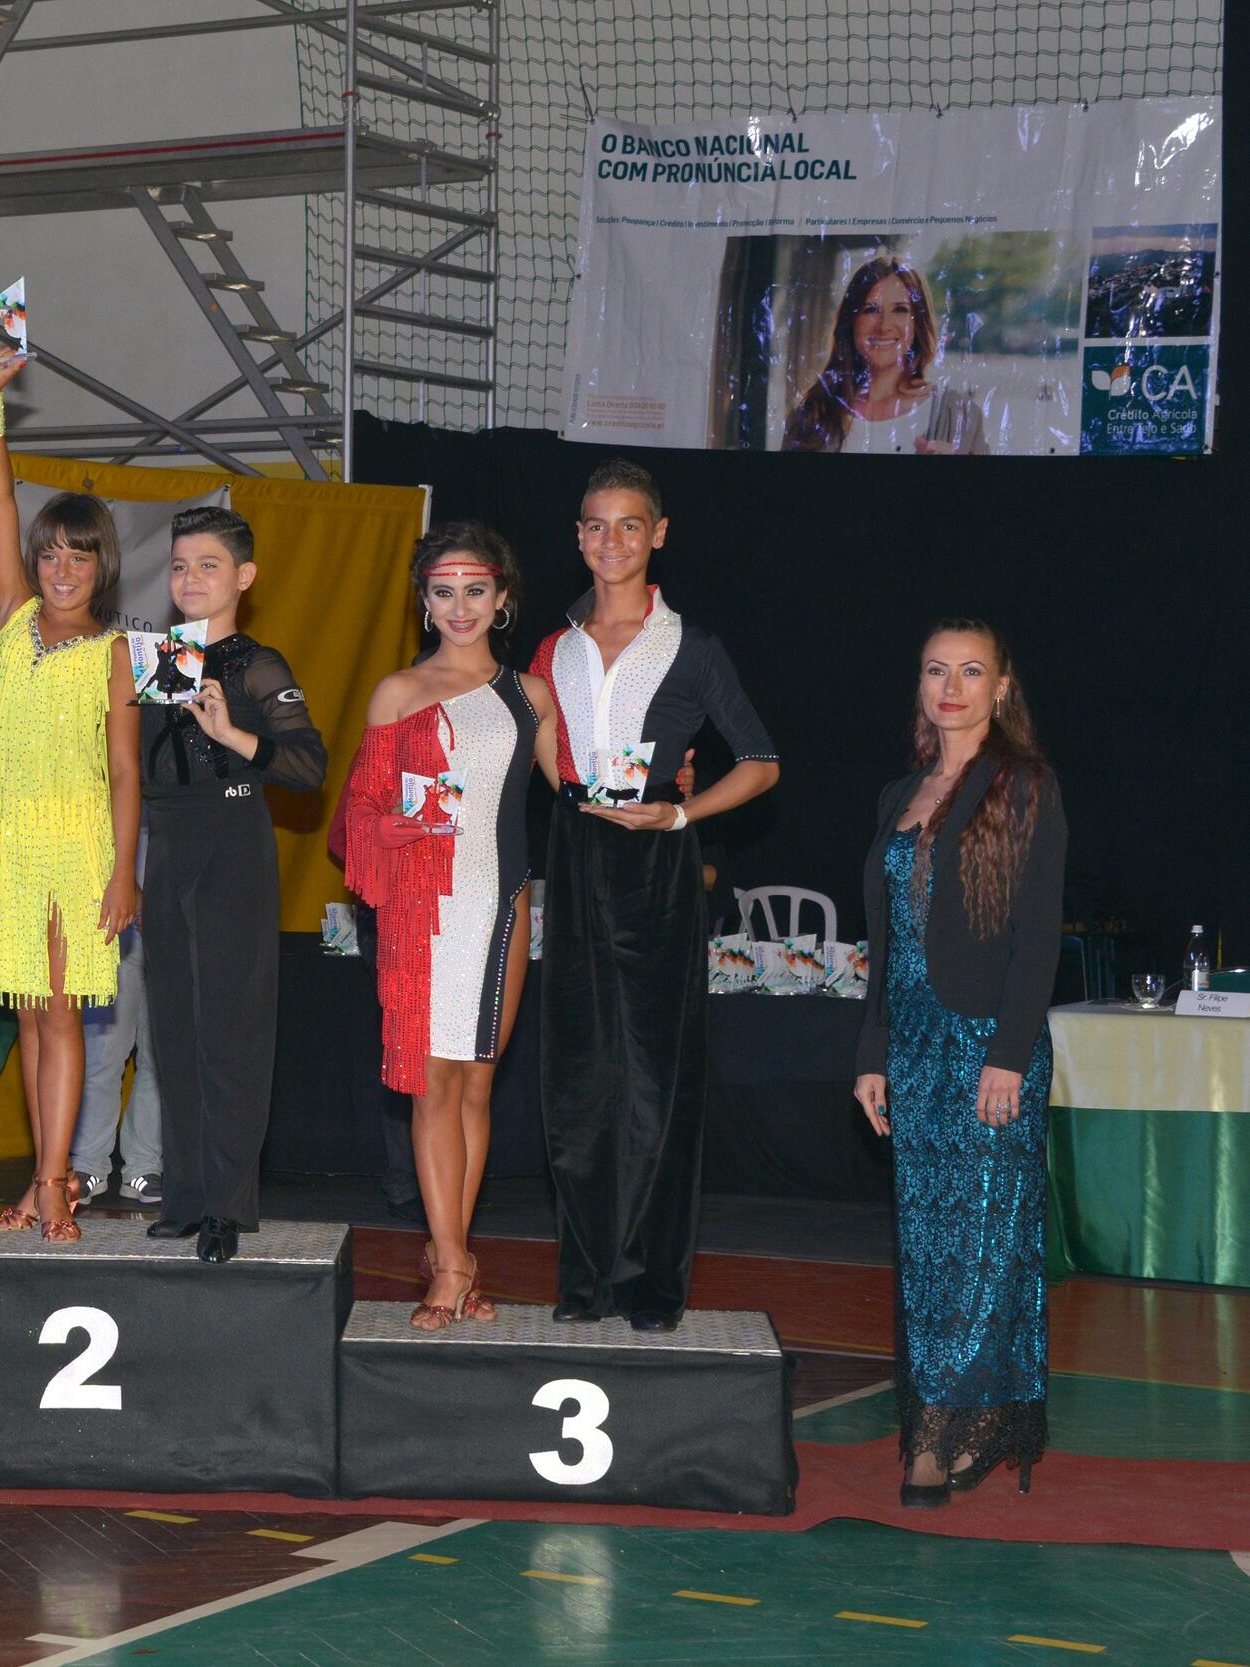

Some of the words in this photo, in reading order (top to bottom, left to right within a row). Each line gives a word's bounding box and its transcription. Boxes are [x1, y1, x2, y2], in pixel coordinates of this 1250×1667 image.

[601, 134, 618, 153] O
[621, 134, 691, 158] BANCO
[693, 133, 810, 156] NACIONAL
[598, 159, 647, 182] COM
[651, 157, 777, 183] PRONÚNCIA
[780, 158, 858, 181] LOCAL
[852, 217, 887, 226] Empresas
[929, 216, 964, 225] Pequenos
[1141, 364, 1198, 401] CA
[1108, 409, 1149, 420] Crédito
[1152, 408, 1198, 422] Agrícola
[1106, 423, 1134, 434] Entre
[1160, 425, 1168, 434] e
[135, 637, 145, 668] Montijo
[407, 777, 415, 803] Montijo
[38, 1306, 122, 1411] 2
[528, 1378, 614, 1486] 3
